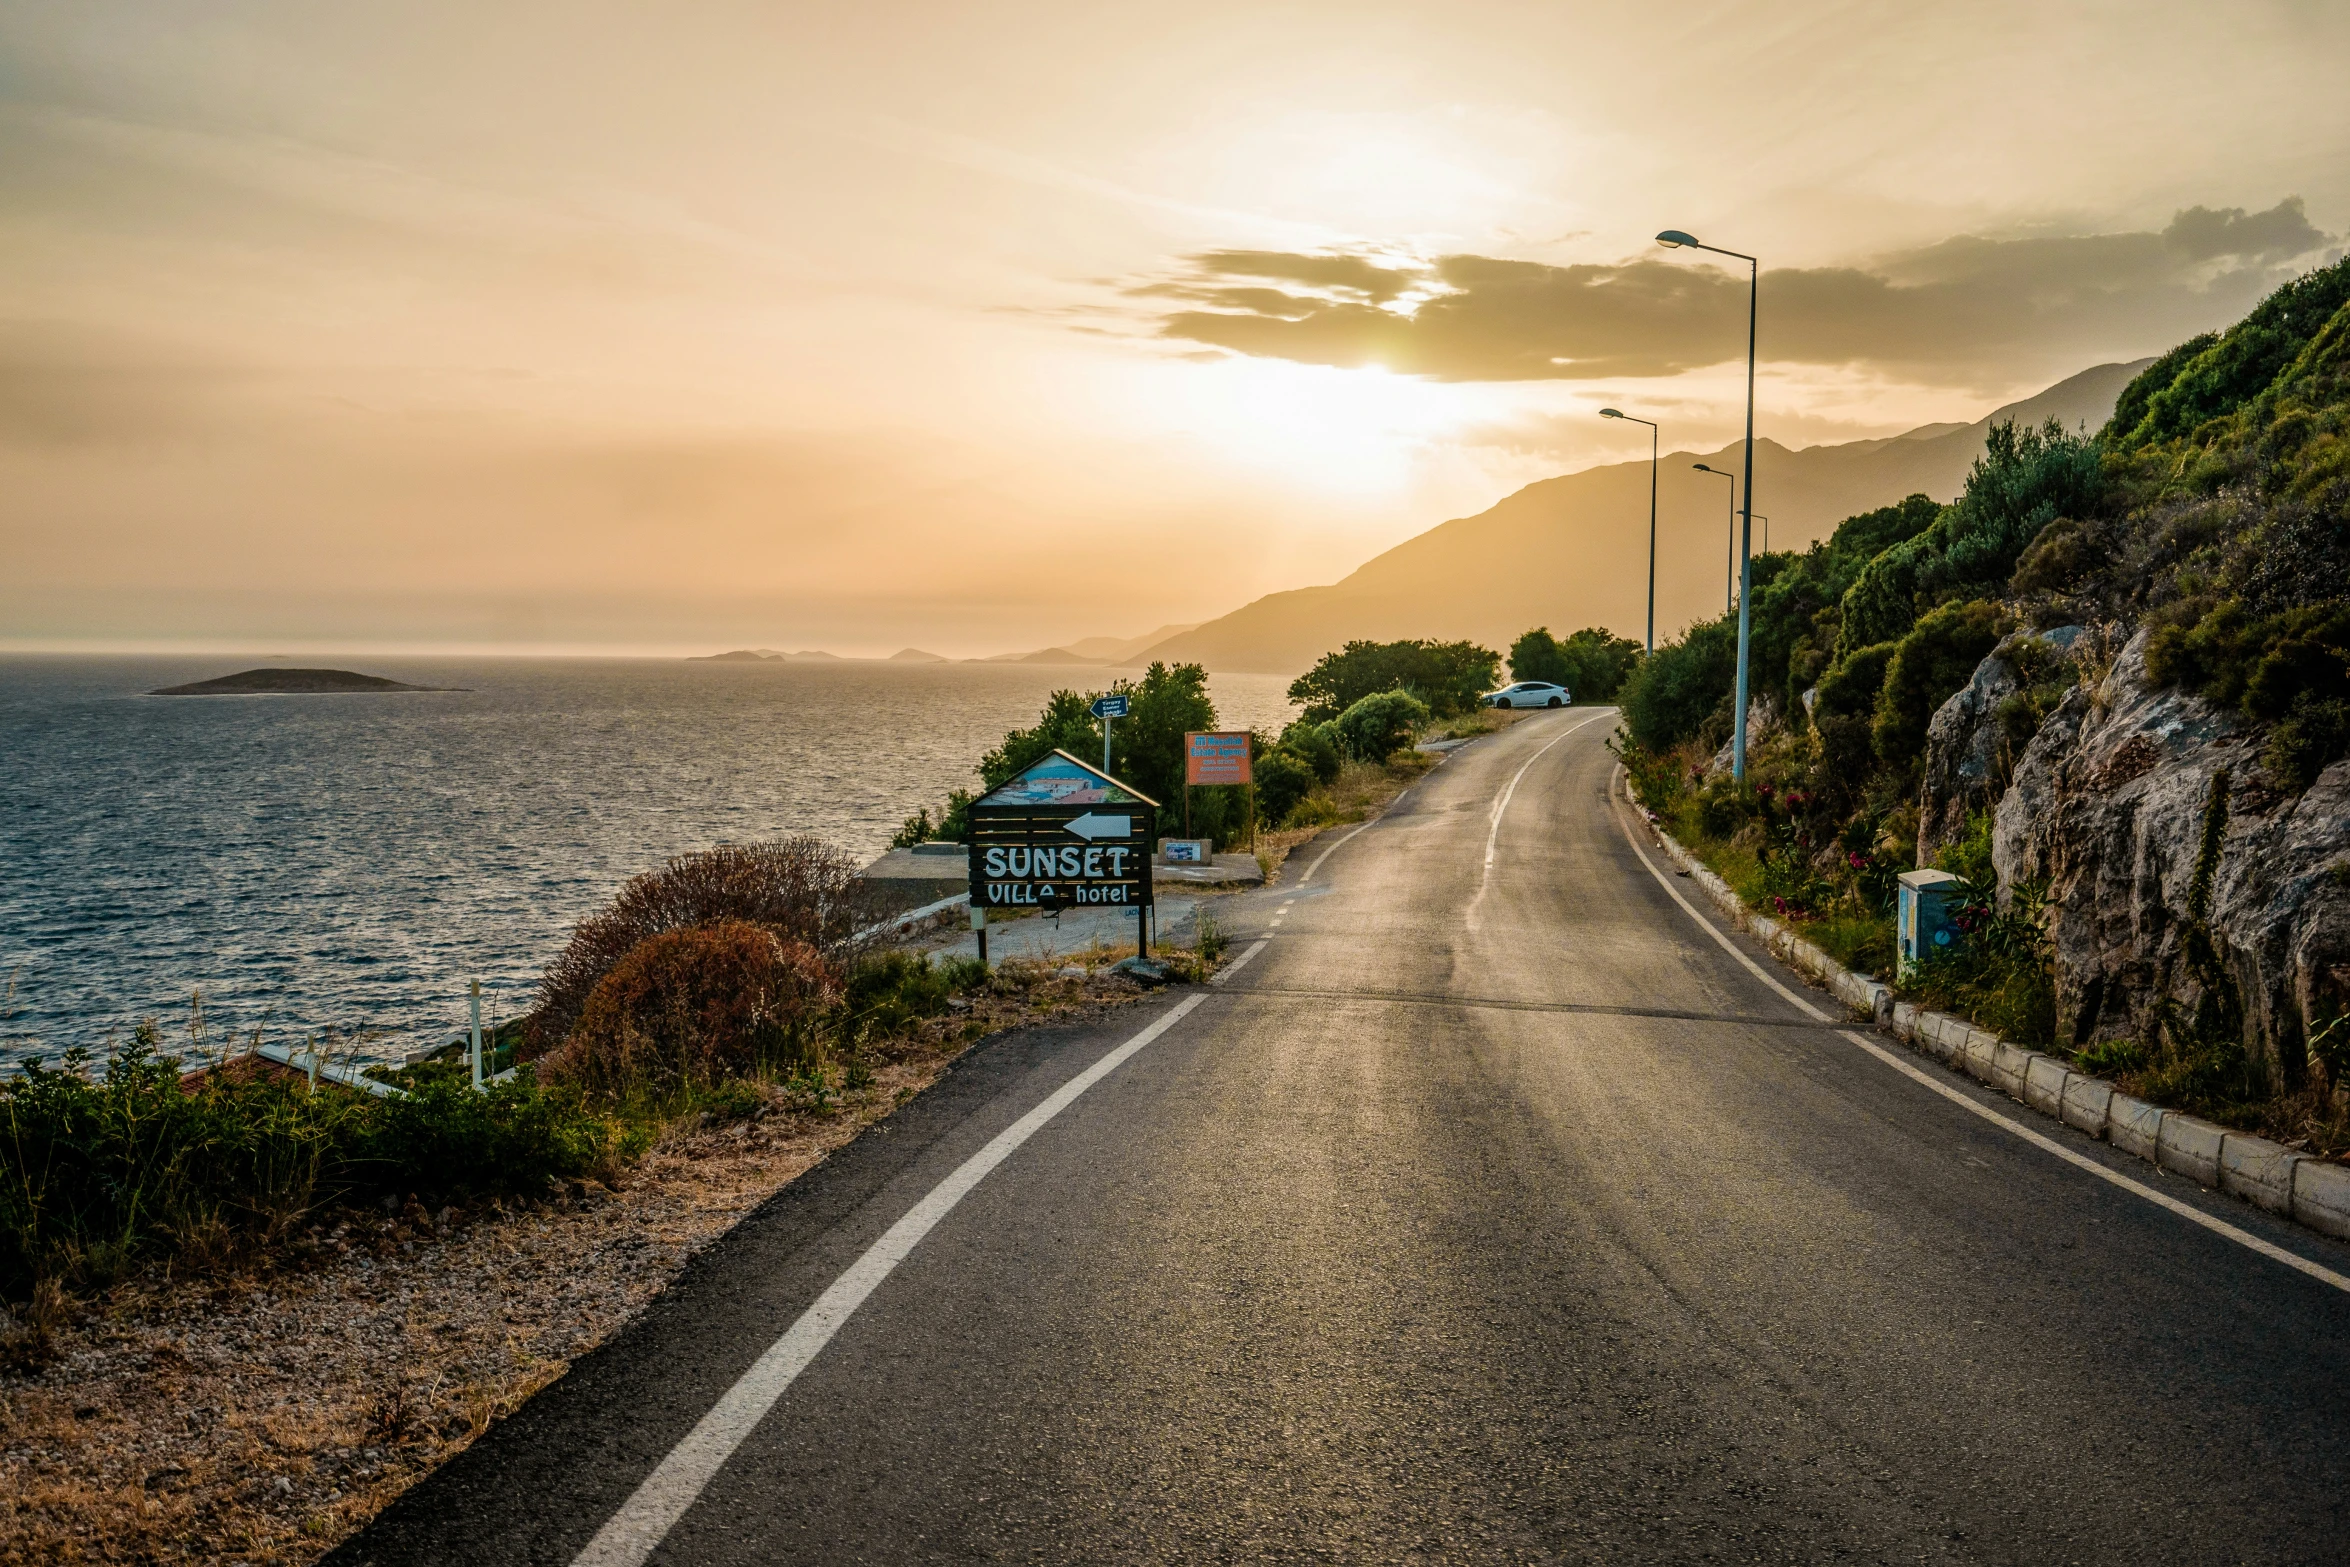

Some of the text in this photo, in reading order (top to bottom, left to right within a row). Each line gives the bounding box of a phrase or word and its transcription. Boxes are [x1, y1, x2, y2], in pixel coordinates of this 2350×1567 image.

[1190, 747, 1216, 757] Estate
[985, 847, 1129, 877] SUNSET
[988, 884, 1128, 904] VILLA hotel
